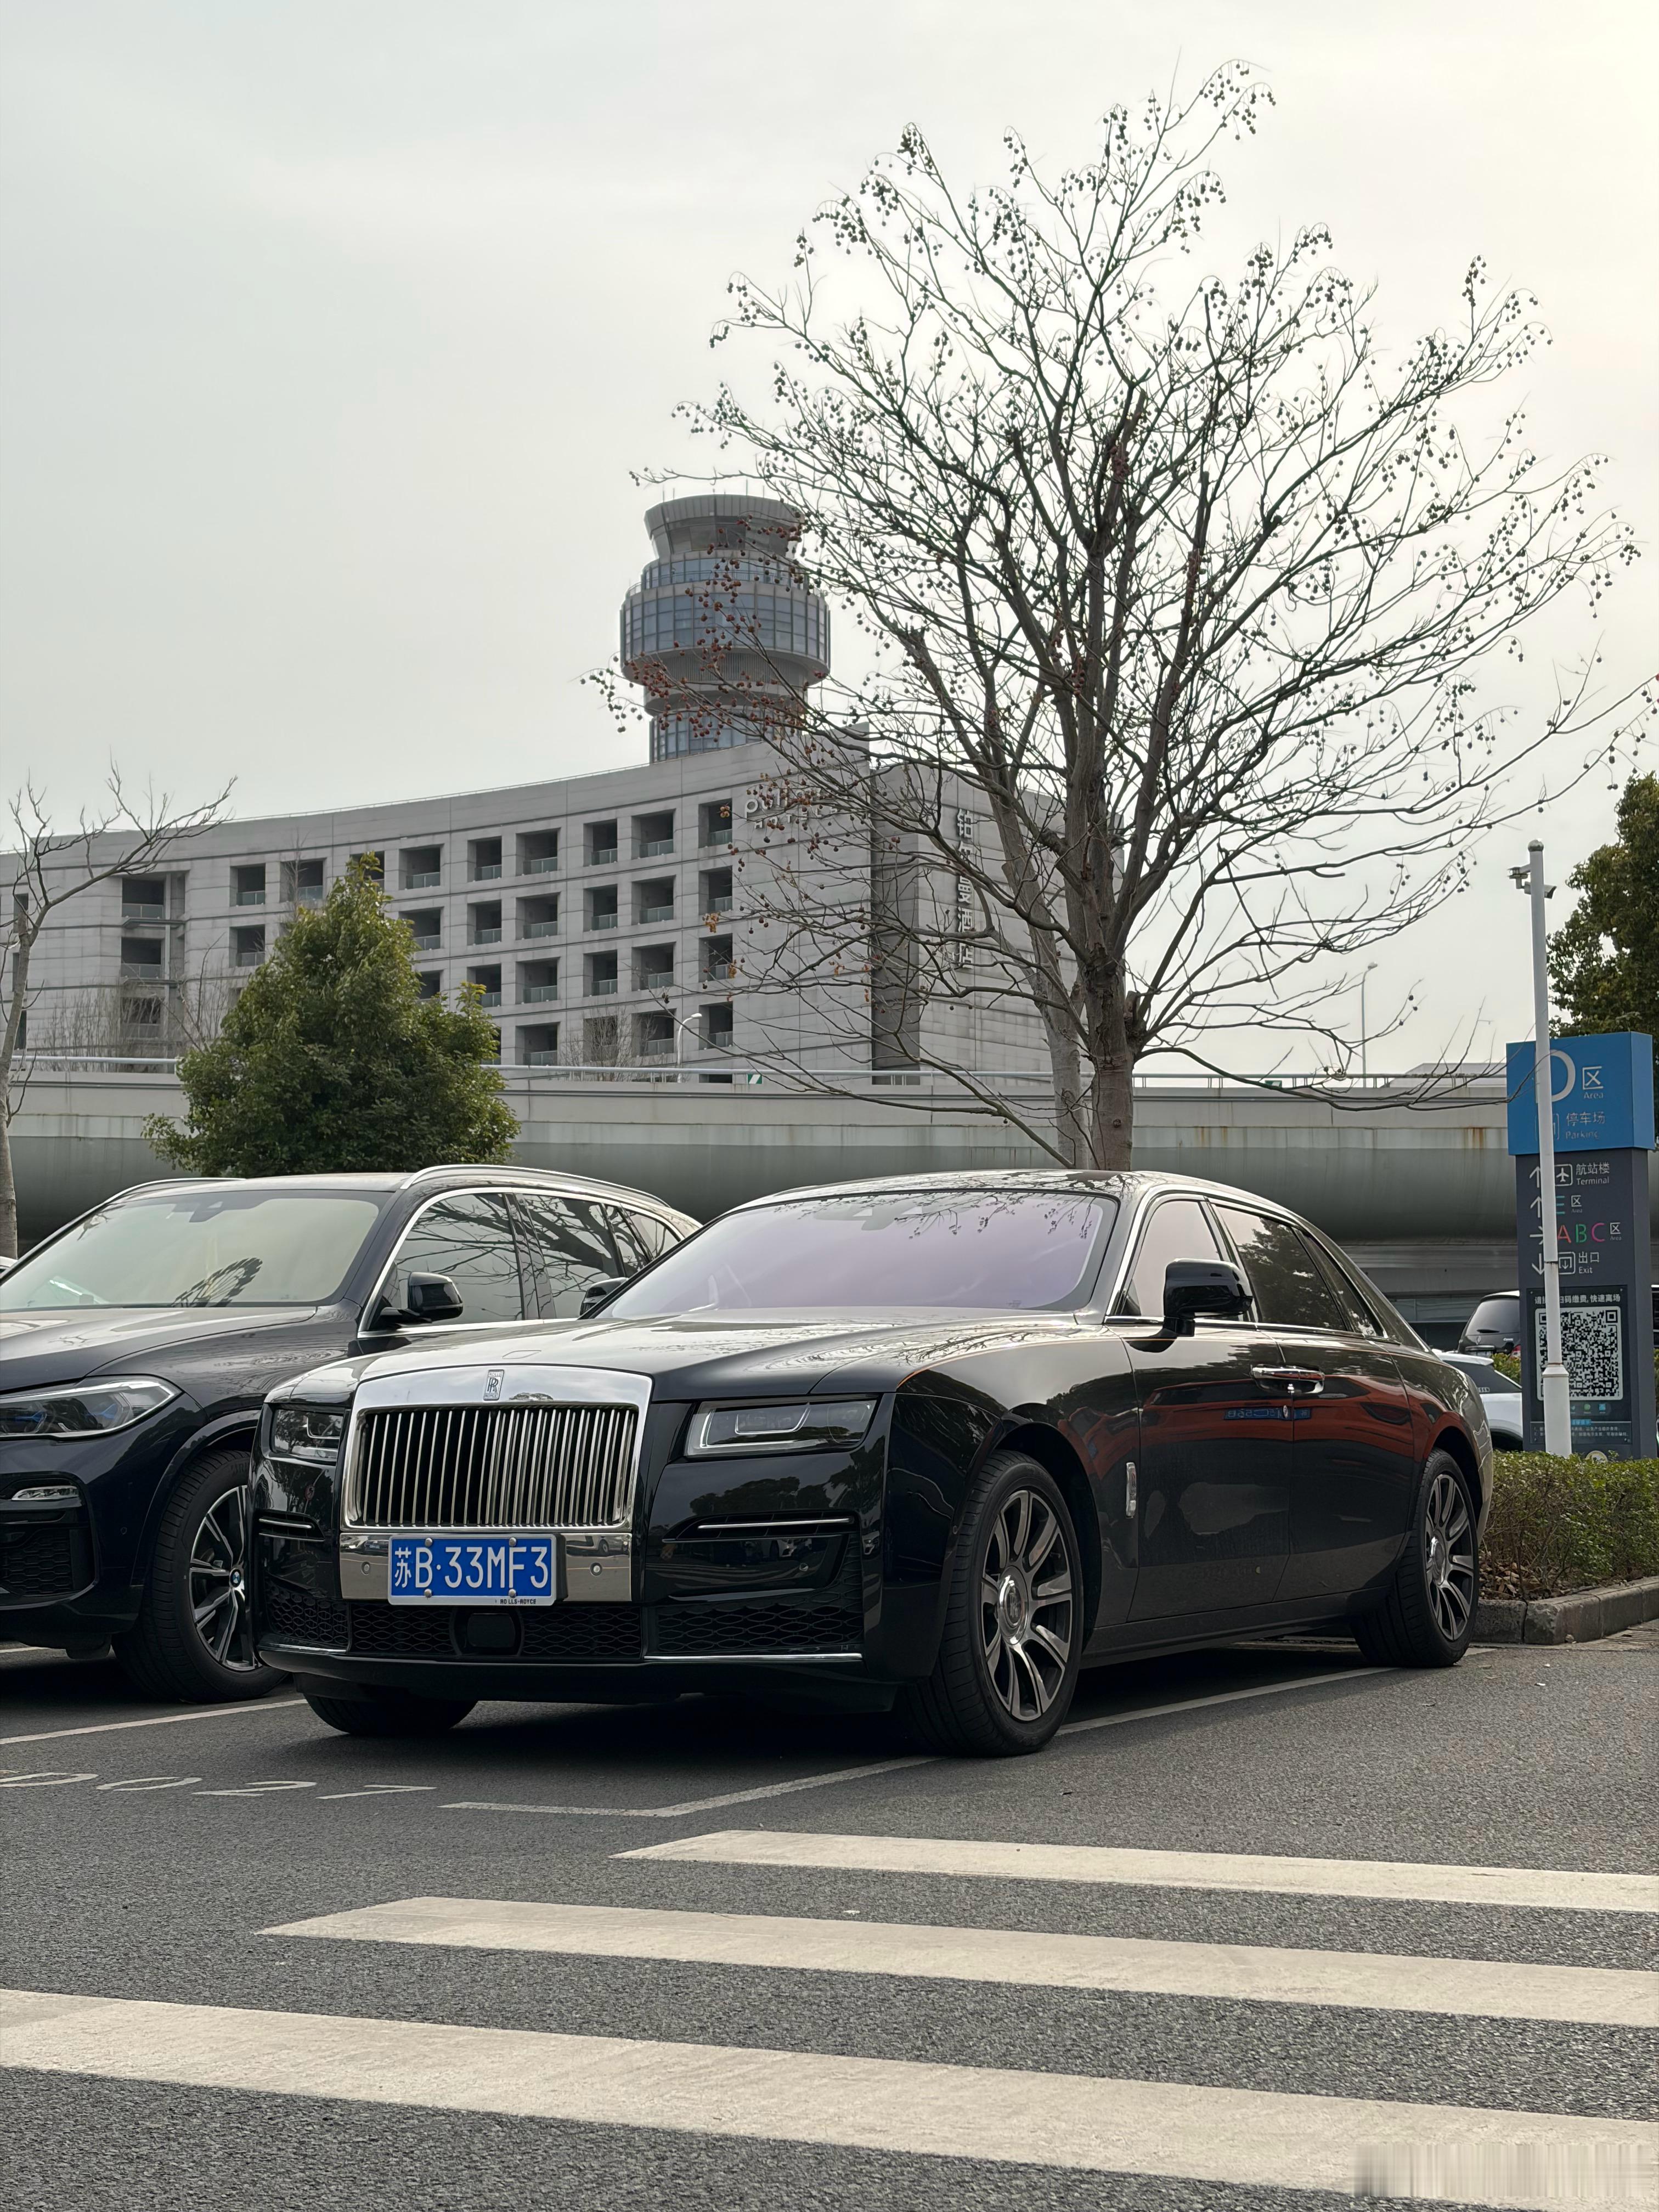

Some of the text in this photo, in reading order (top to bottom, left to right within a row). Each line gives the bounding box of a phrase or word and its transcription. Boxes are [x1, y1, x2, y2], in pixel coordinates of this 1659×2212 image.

[1582, 1066, 1604, 1090] 区
[1583, 1091, 1604, 1099] Area
[1566, 1111, 1606, 1126] 停车场
[1565, 1130, 1600, 1141] Parking
[1576, 1162, 1610, 1175] 航站楼
[1576, 1177, 1610, 1186] Terminal
[1571, 1195, 1582, 1207] 区
[1610, 1222, 1621, 1234] 区
[1578, 1251, 1600, 1263] 出口
